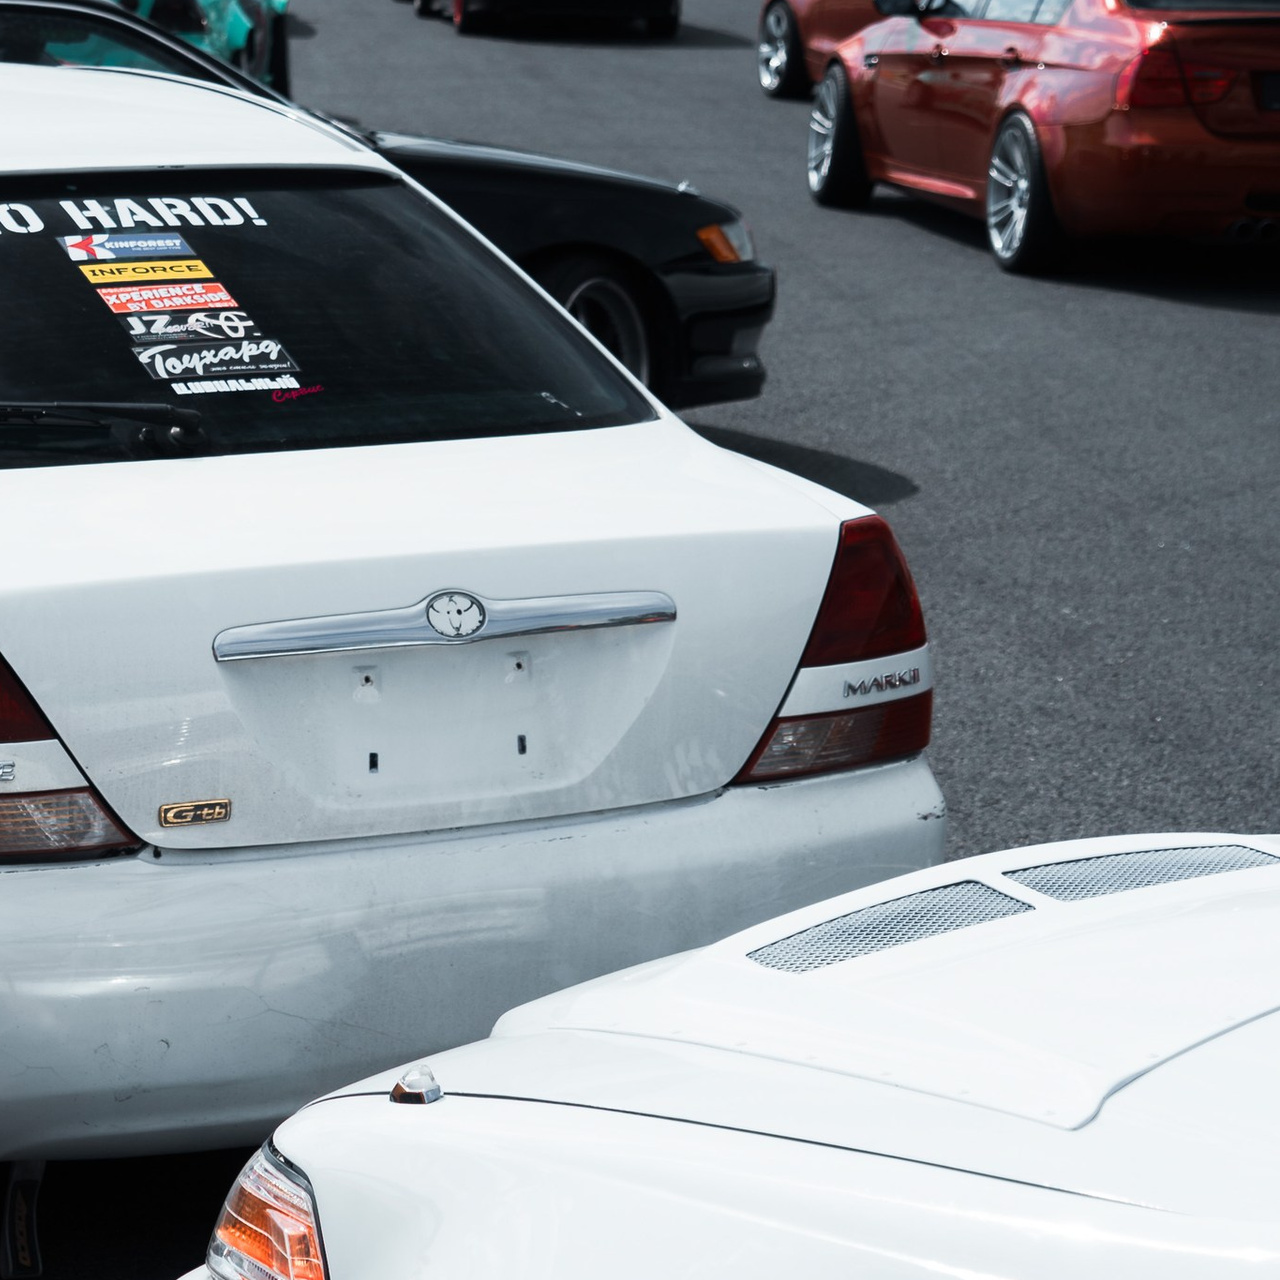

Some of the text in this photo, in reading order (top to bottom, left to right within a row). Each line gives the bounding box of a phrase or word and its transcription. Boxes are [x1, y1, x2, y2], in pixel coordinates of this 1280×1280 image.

[59, 197, 268, 230] HARD!
[104, 239, 181, 249] KINFOREST
[89, 265, 202, 277] INFORCE
[105, 284, 206, 305] XPERIENCE
[127, 302, 148, 311] BY
[151, 292, 232, 308] DARKSIDE
[843, 670, 909, 698] MARK
